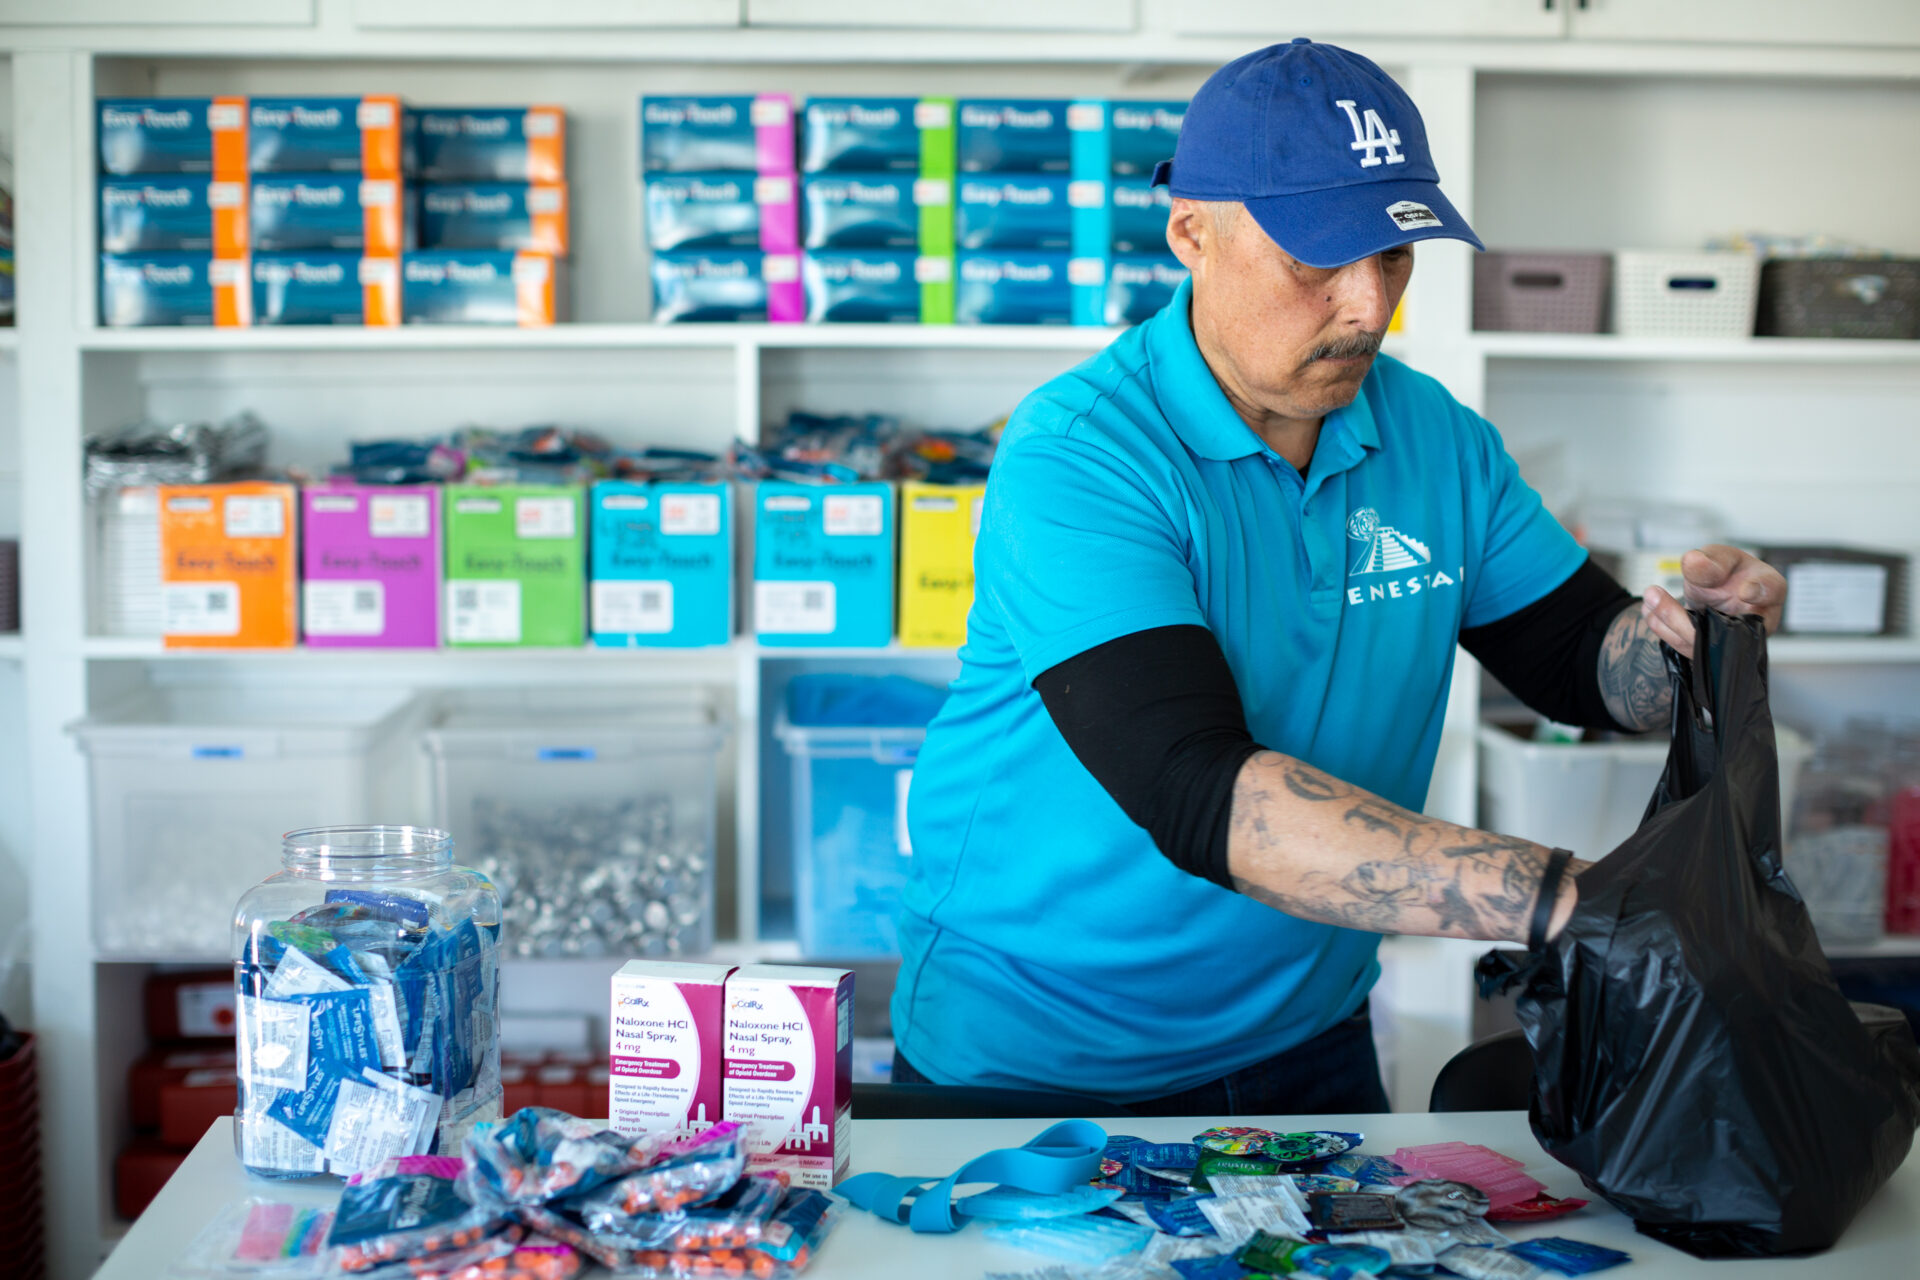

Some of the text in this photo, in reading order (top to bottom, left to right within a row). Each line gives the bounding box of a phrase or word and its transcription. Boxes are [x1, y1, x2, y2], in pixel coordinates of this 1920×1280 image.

[1336, 100, 1405, 168] LA
[1347, 566, 1464, 606] ENESTA
[616, 1016, 664, 1028] Naloxone
[729, 1020, 780, 1030] Naloxone
[616, 1029, 677, 1043] Nasal Spray,
[729, 1032, 792, 1045] Nasal Spray,
[616, 1041, 641, 1053] 4 mg
[729, 1045, 755, 1057] 4 mg
[614, 1058, 670, 1068] Emergency Treatment
[728, 1061, 785, 1071] Emergency Treatment
[621, 1066, 638, 1074] Opioid
[638, 1067, 663, 1075] Overdose
[735, 1069, 752, 1077] Opioid
[752, 1070, 777, 1078] Overdose
